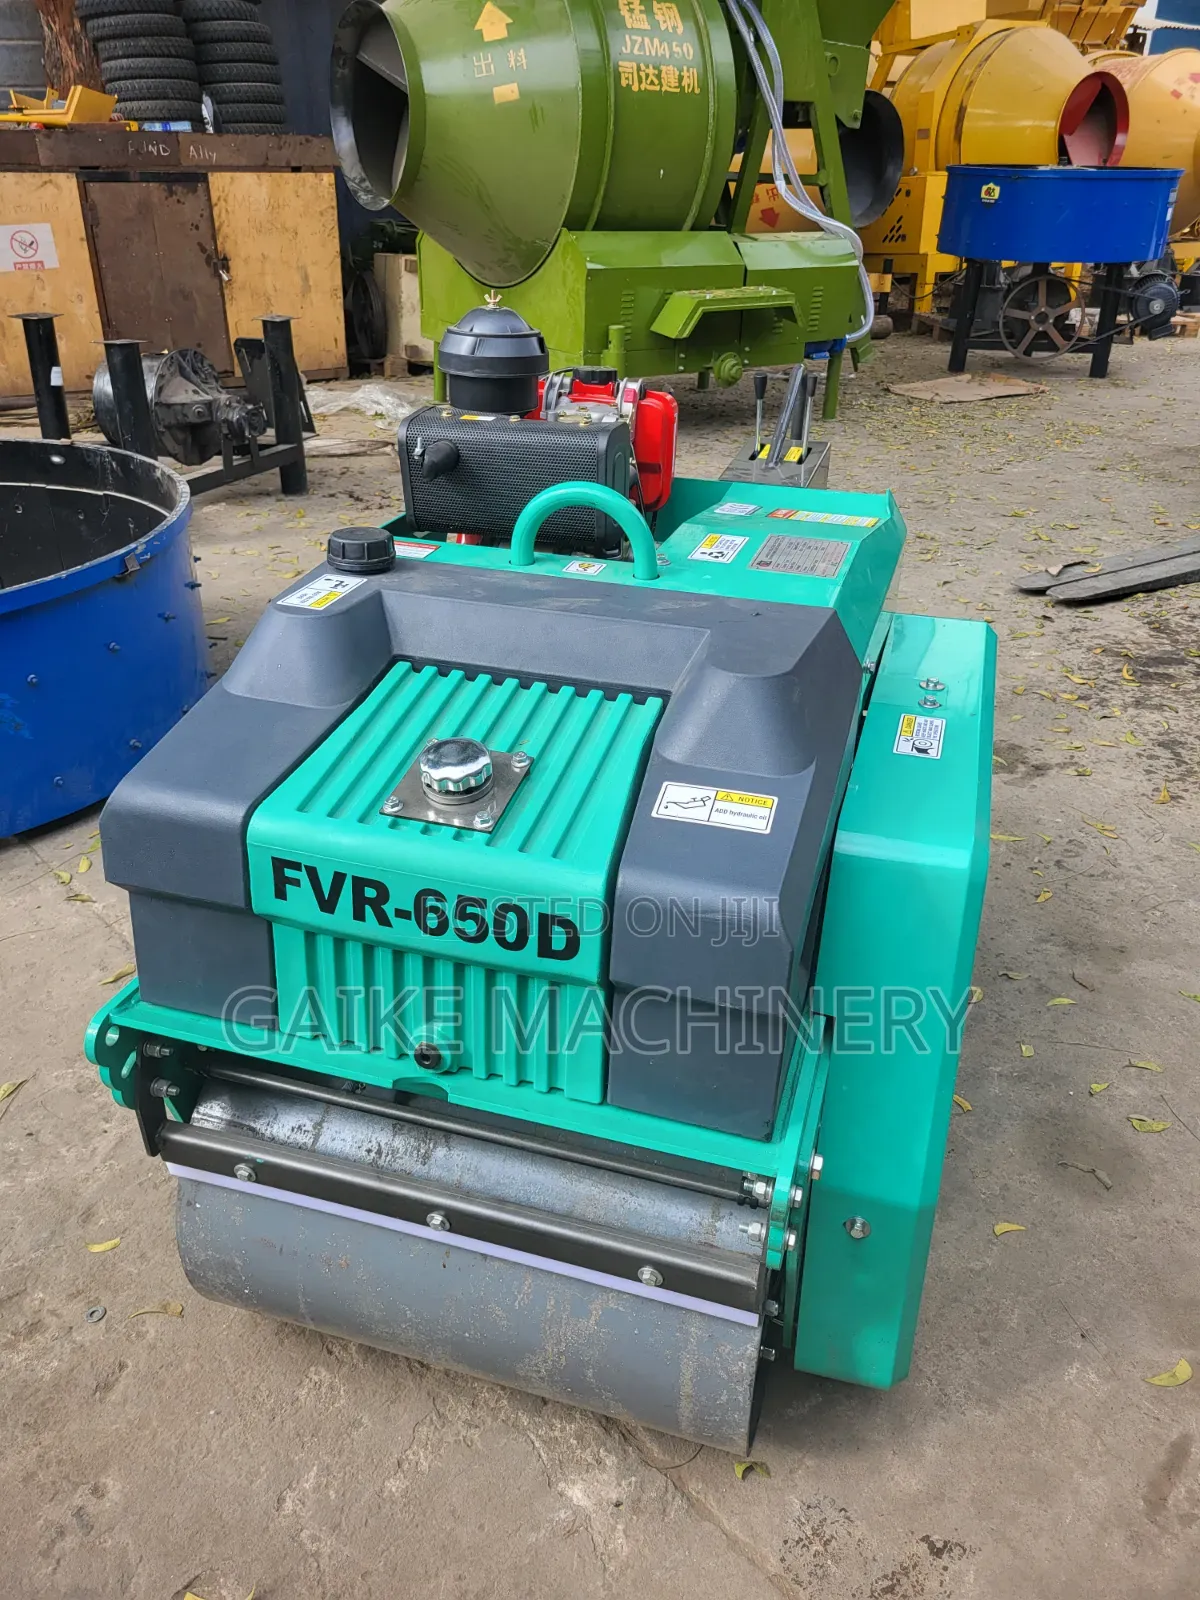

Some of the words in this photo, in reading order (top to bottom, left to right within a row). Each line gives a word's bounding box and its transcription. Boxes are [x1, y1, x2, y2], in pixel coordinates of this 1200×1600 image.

[621, 34, 694, 60] JZM450
[473, 48, 527, 77] 出料
[618, 61, 701, 94] 司达建机
[729, 809, 758, 819] hydraulic
[738, 796, 768, 805] NOTICE
[271, 856, 580, 961] FVR-650D
